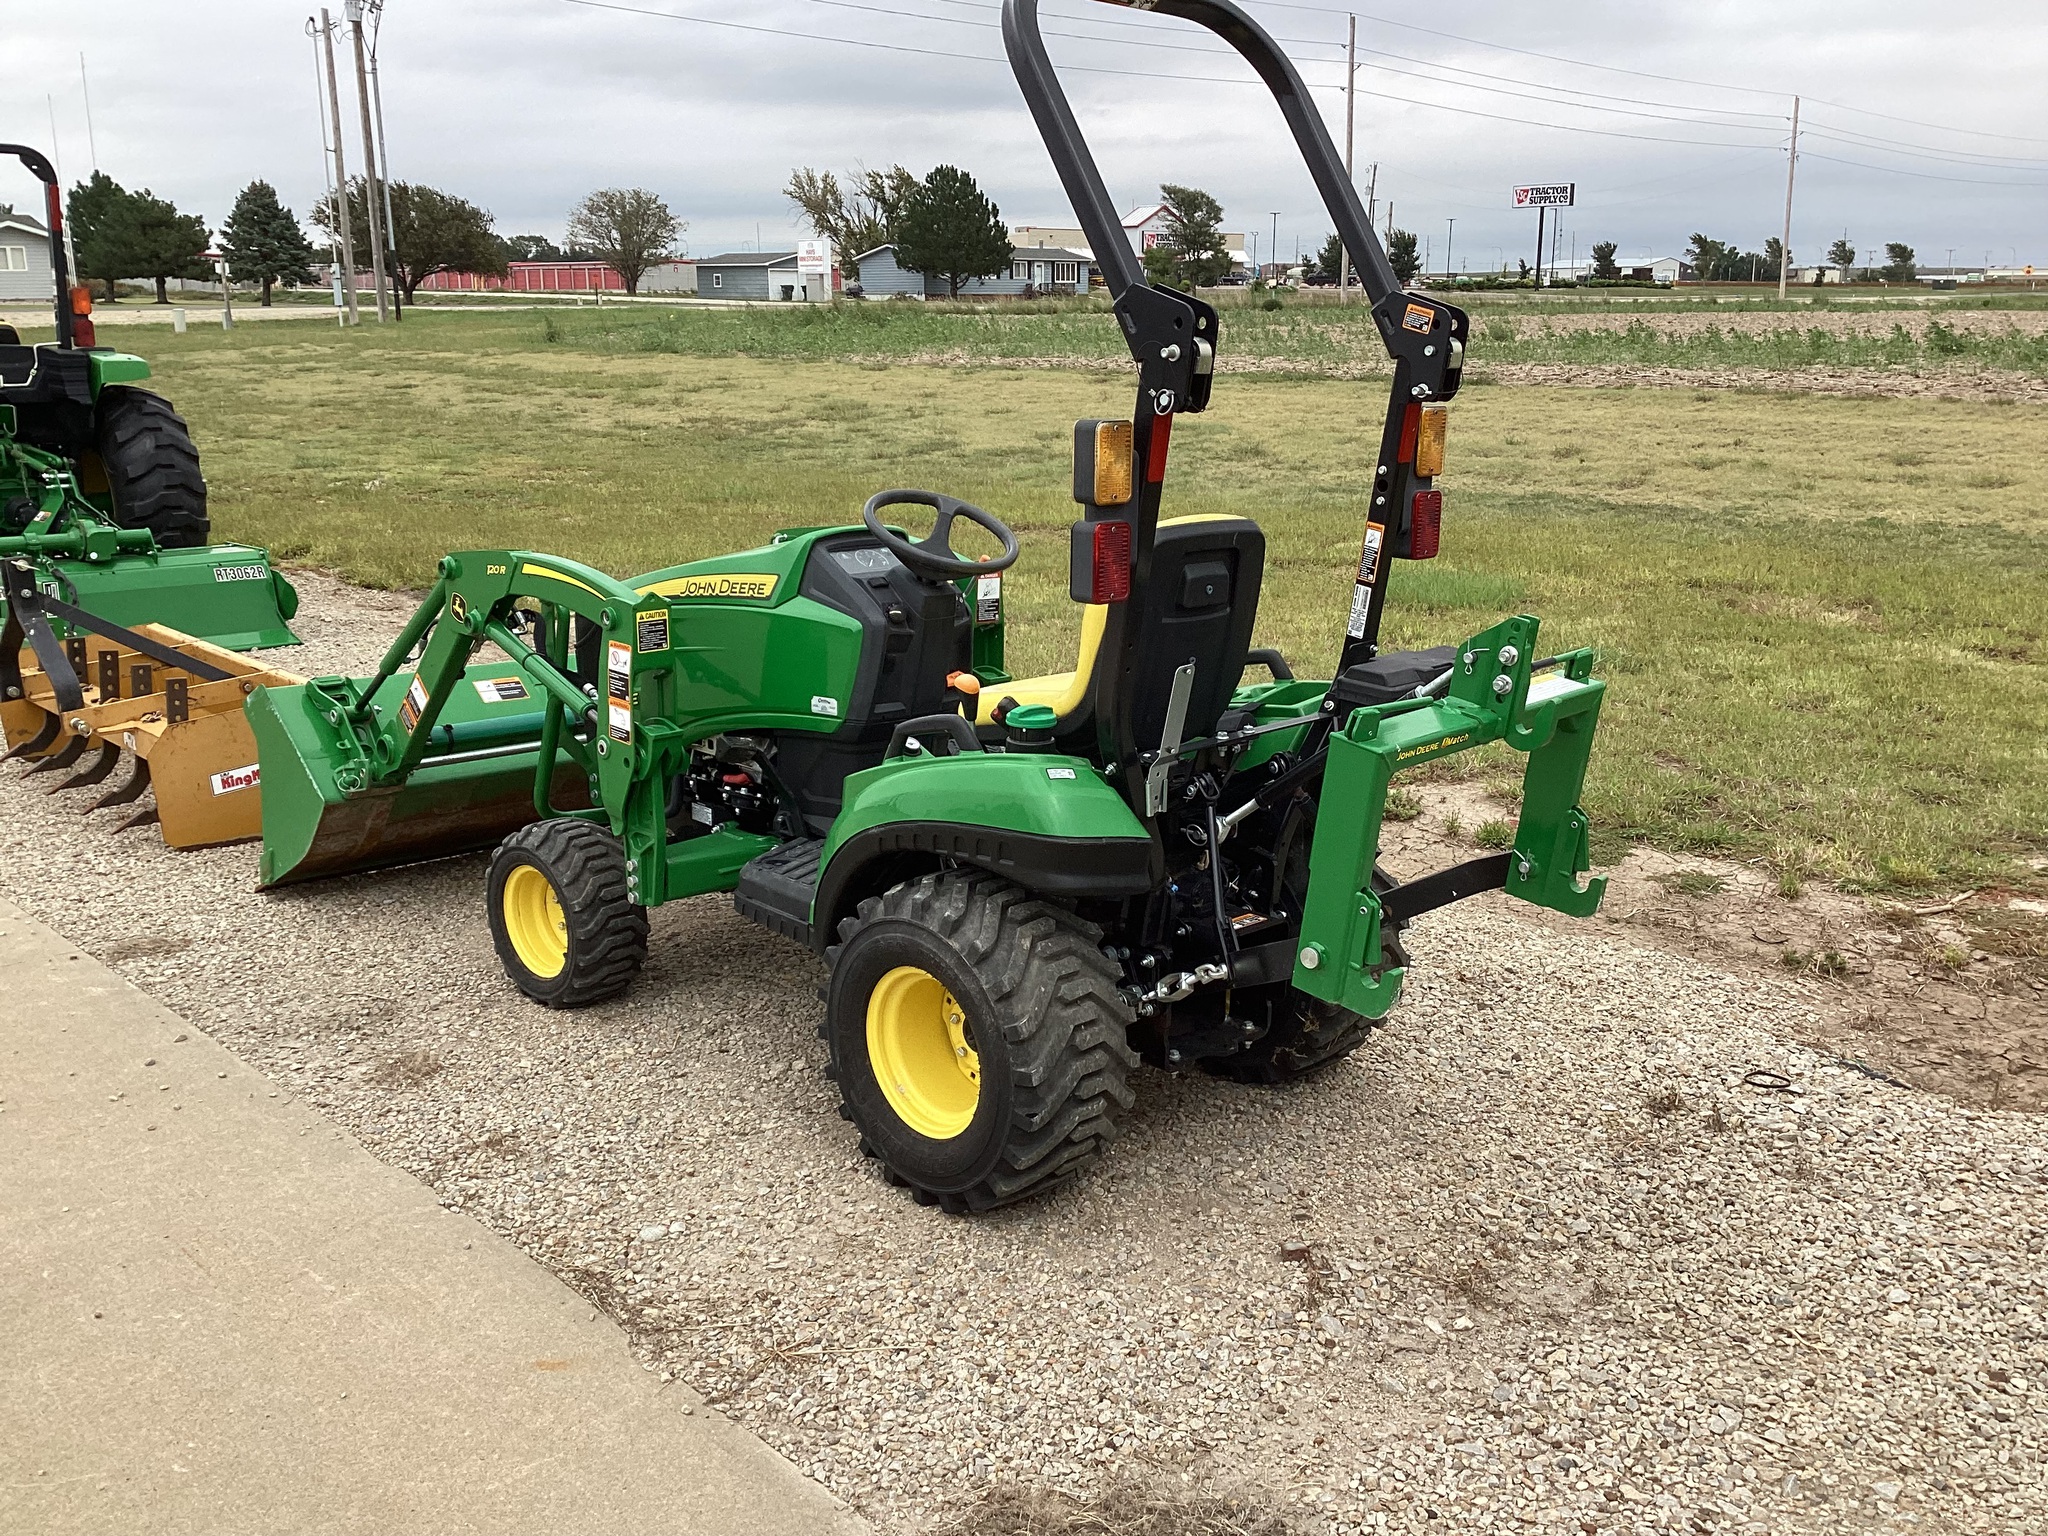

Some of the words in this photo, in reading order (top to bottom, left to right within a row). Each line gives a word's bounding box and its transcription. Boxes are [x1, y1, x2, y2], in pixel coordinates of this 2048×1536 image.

[1530, 186, 1568, 195] TRACTOR
[1529, 195, 1557, 204] SUPPLY
[215, 566, 265, 581] RT3062R
[680, 581, 717, 595] JOHN
[719, 580, 766, 595] DEERE
[645, 610, 667, 620] CAUTION
[1397, 749, 1416, 761] JOHN
[1416, 742, 1439, 755] DEERE
